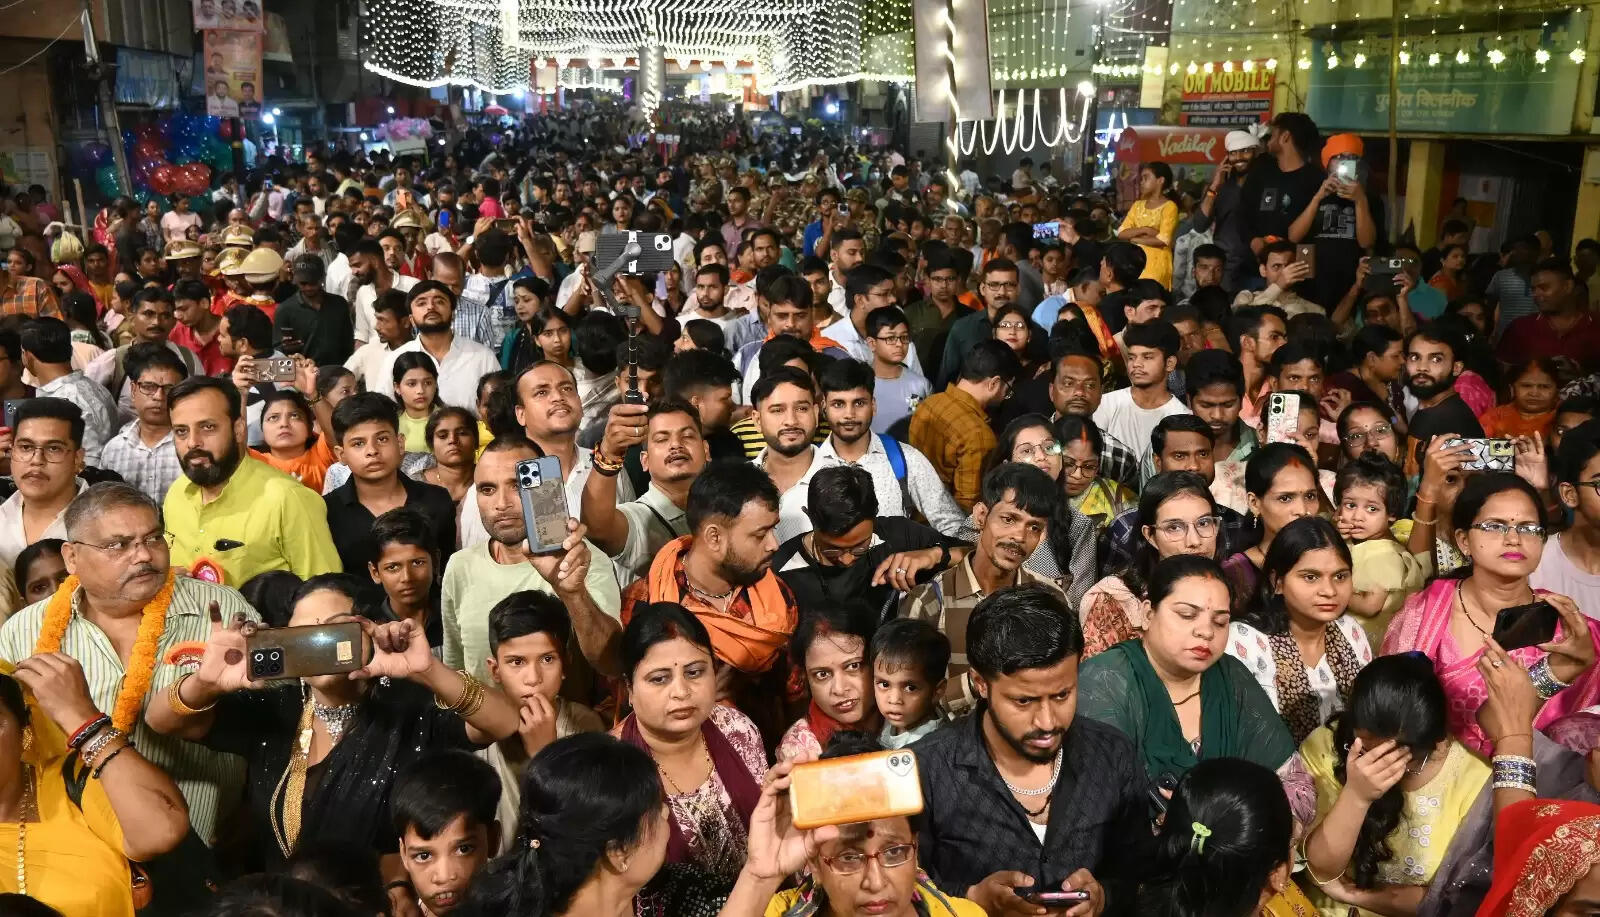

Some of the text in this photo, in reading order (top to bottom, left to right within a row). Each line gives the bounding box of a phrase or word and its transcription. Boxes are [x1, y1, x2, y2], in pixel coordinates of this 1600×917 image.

[1184, 70, 1271, 93] OM MOBILE
[1158, 133, 1216, 160] Vadilal
